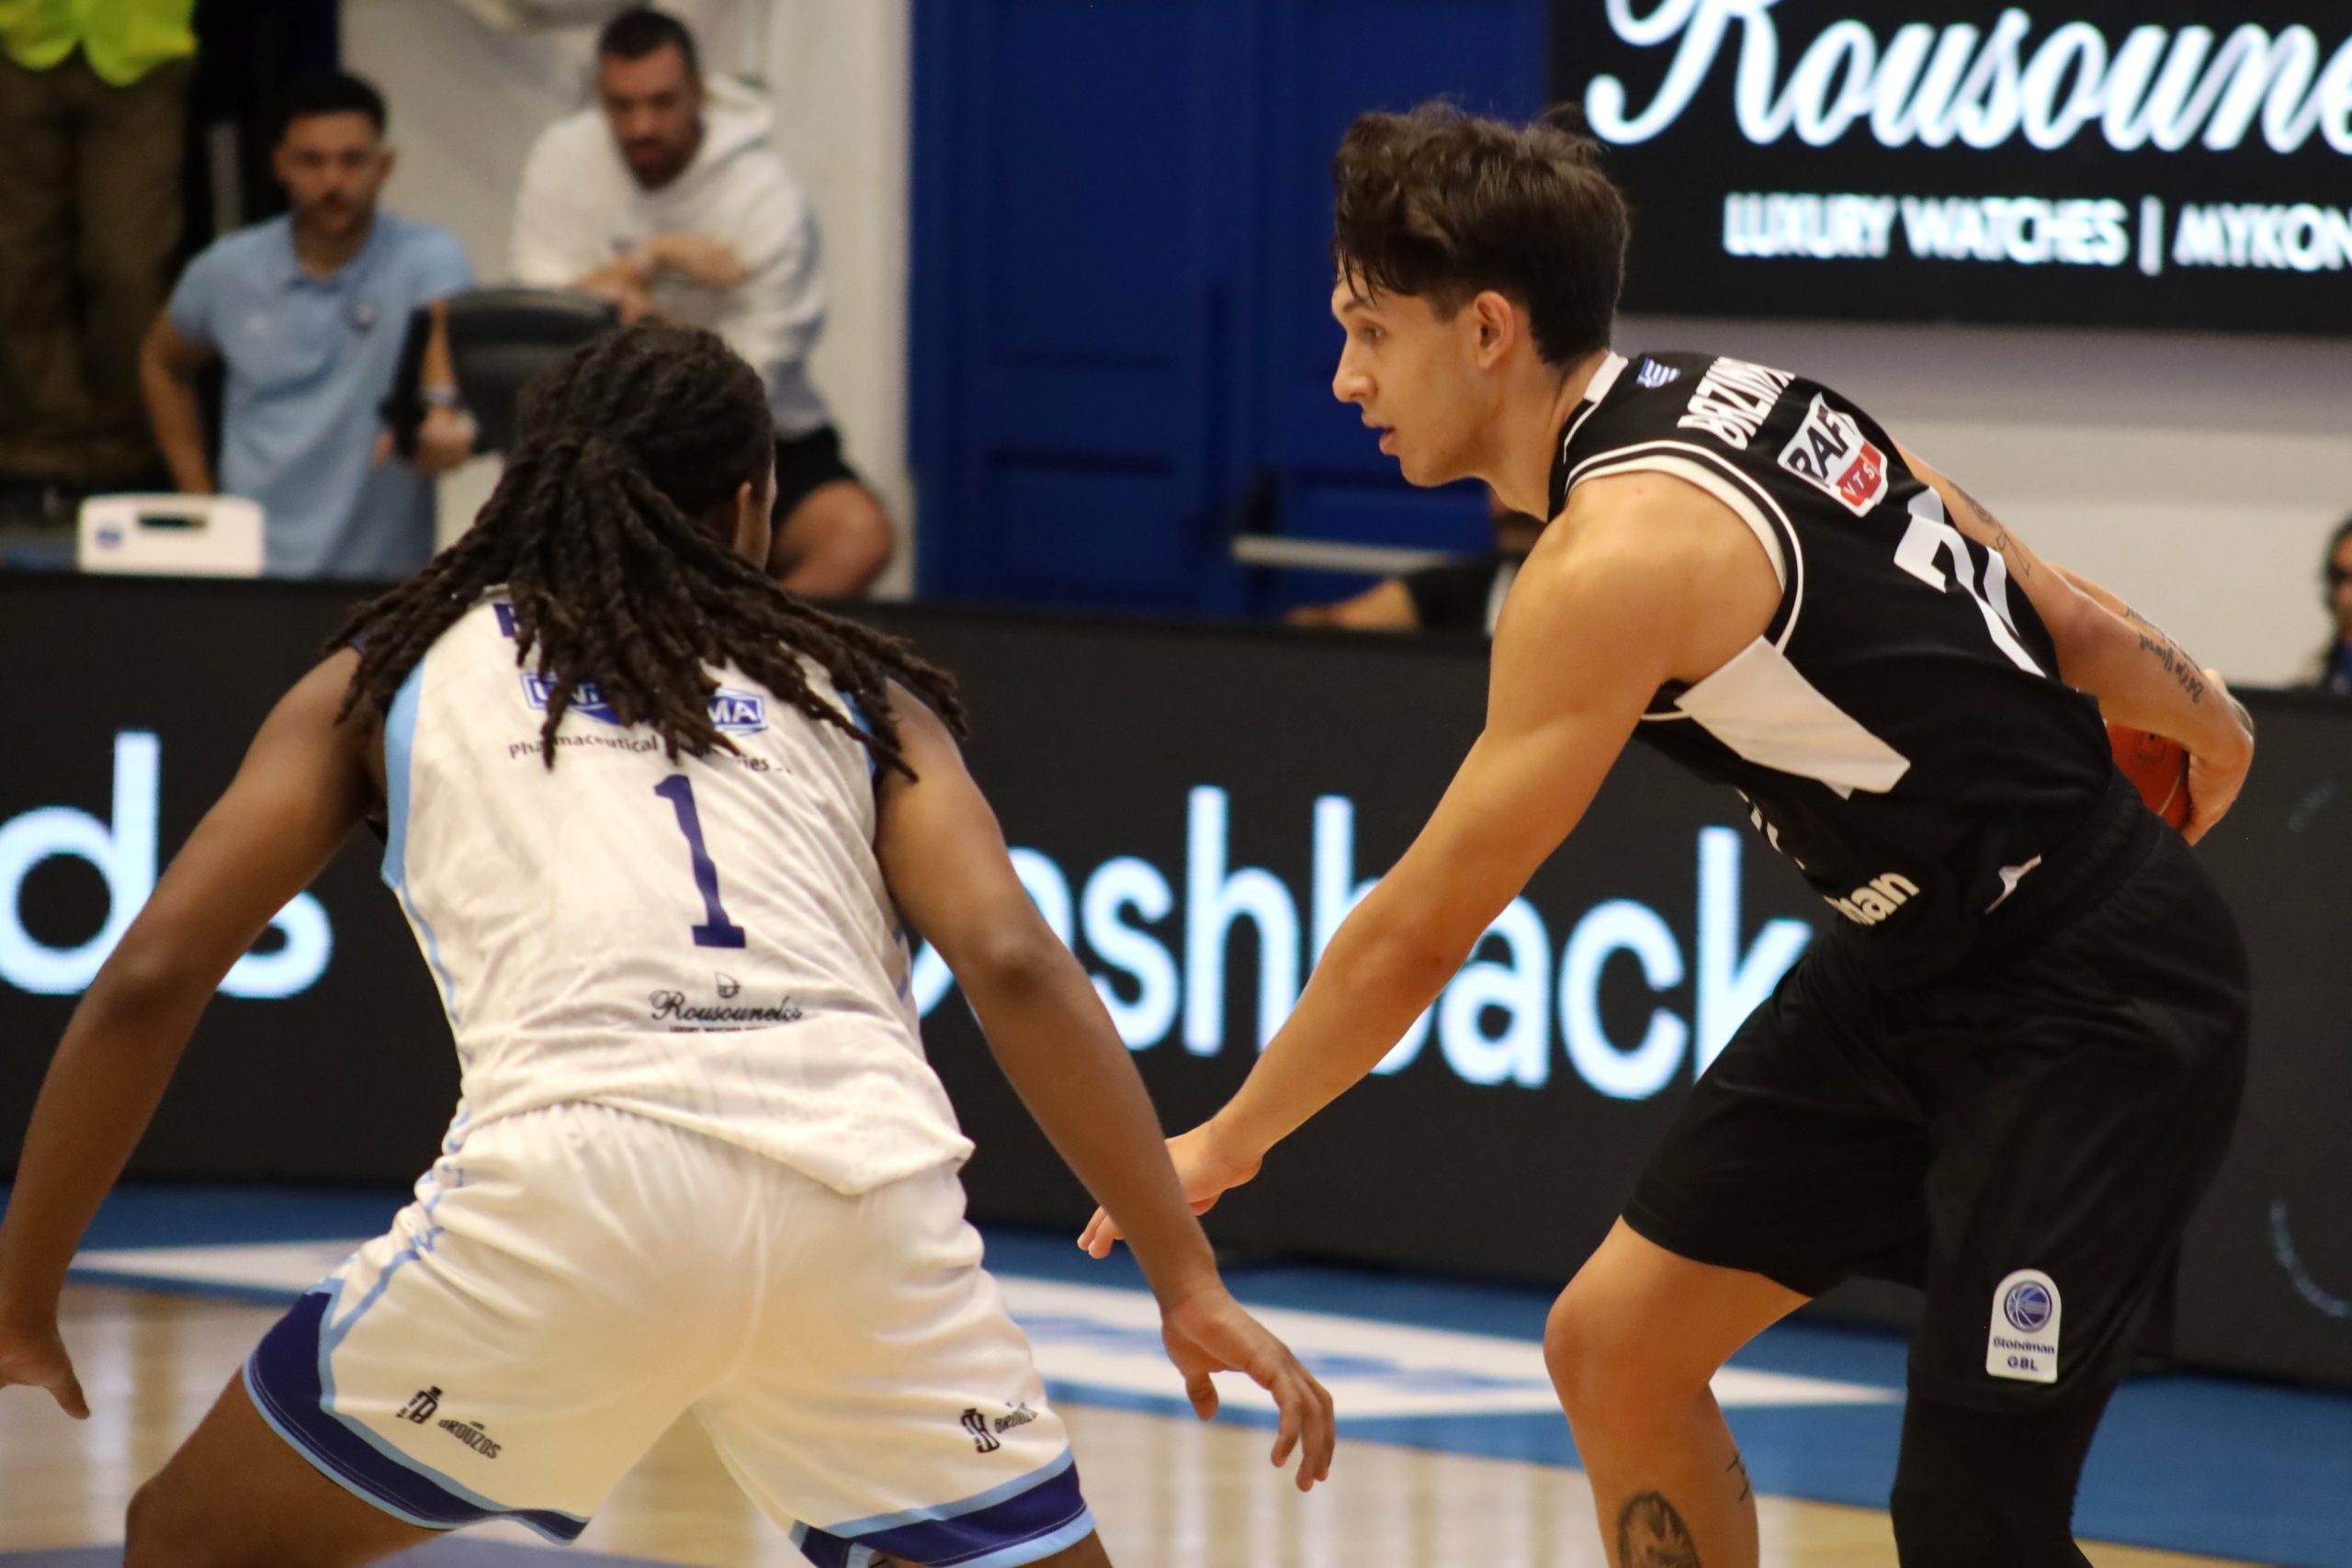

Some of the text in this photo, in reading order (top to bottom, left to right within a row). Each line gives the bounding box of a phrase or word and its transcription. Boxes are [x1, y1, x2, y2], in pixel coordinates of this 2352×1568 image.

[1724, 193, 1898, 258] LUXURY
[1903, 197, 2129, 267] WATCHES
[508, 734, 660, 760] Phamaceutical
[653, 774, 746, 949] 1
